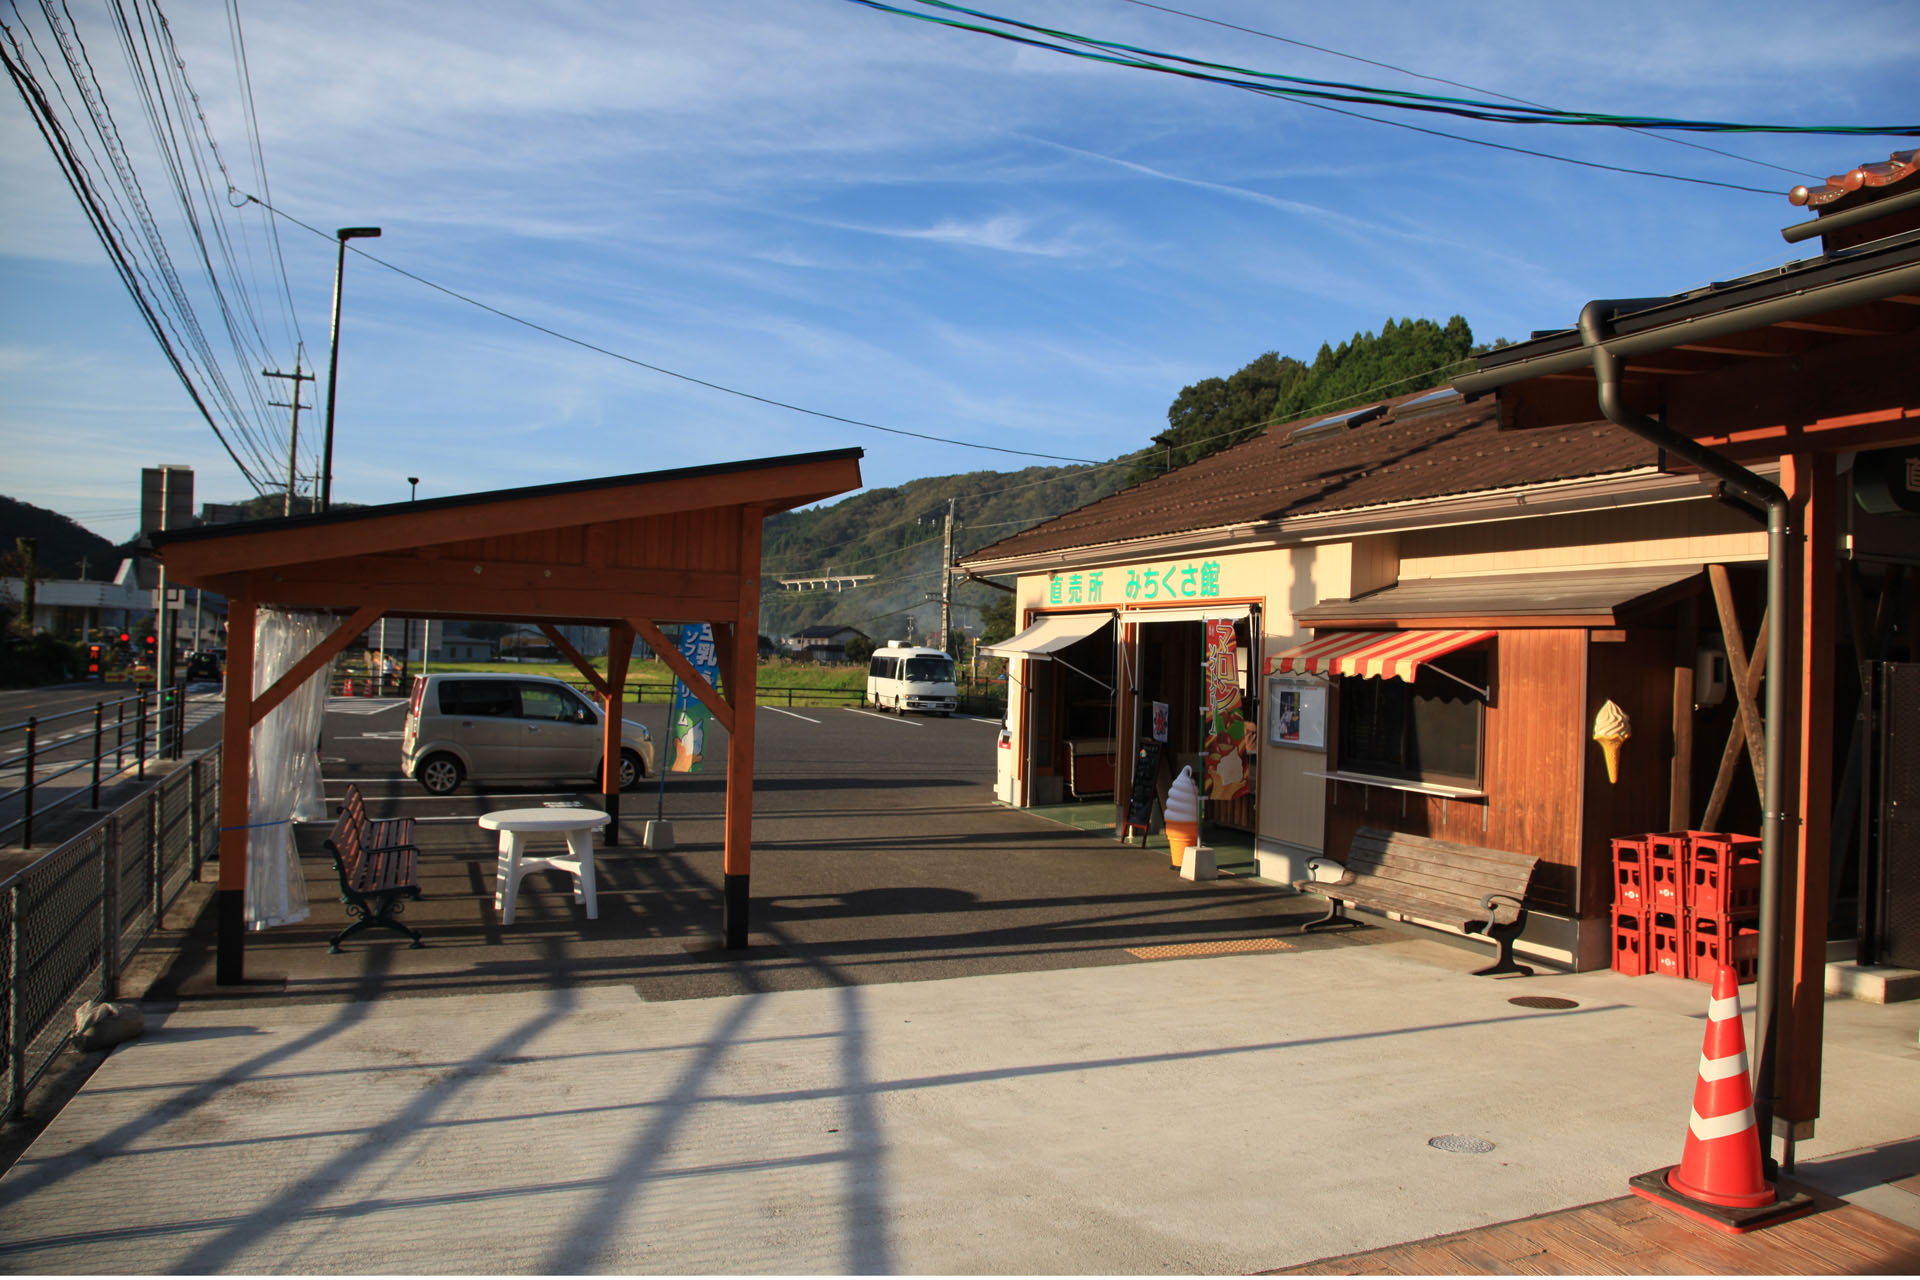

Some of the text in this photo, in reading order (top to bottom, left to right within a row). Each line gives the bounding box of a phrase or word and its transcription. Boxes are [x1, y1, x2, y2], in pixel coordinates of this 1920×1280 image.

[1049, 560, 1221, 604] 直売所 みちくさ館
[1208, 642, 1218, 736] ソフトクリーム
[1215, 625, 1239, 711] マロン
